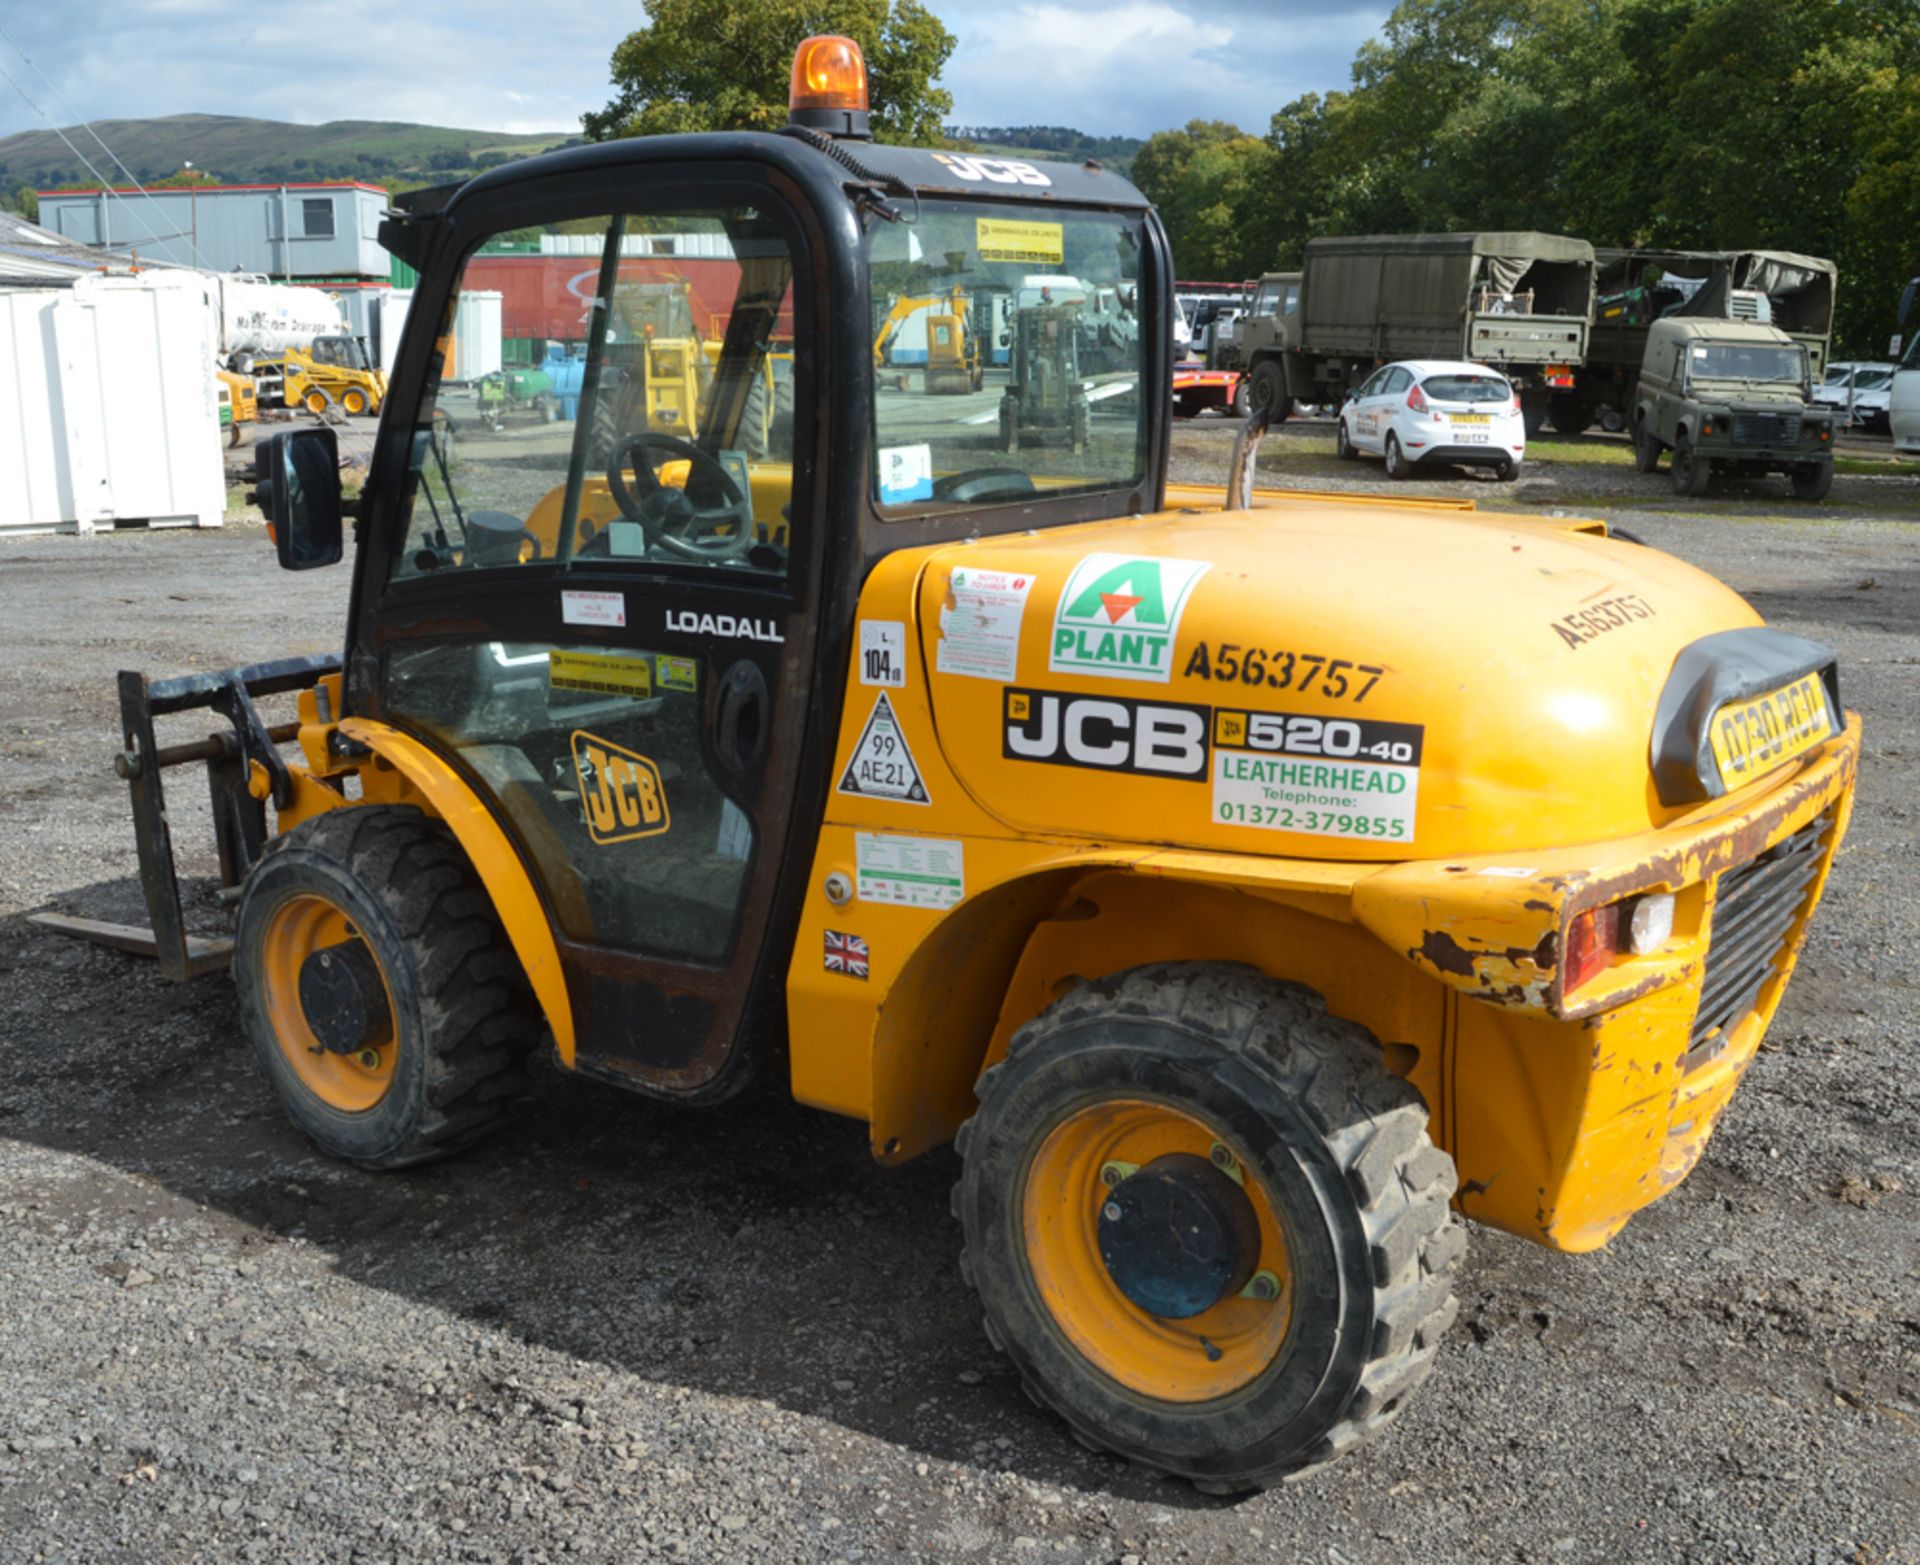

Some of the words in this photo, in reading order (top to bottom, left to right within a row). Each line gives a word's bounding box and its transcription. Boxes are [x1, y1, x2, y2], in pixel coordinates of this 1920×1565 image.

[946, 154, 1053, 187] JCB
[665, 609, 785, 643] LOADALL
[1551, 594, 1657, 651] A563757
[864, 648, 892, 681] 104
[1054, 628, 1169, 667] PLANT
[1184, 641, 1384, 703] A563757
[872, 734, 896, 757] 99
[1007, 696, 1205, 775] JCB
[1248, 713, 1413, 763] 520-40
[585, 745, 662, 833] JCB
[1223, 757, 1407, 795] LEATHERHEAD
[1262, 787, 1357, 808] Telephone:
[1219, 802, 1405, 838] 01372-379855
